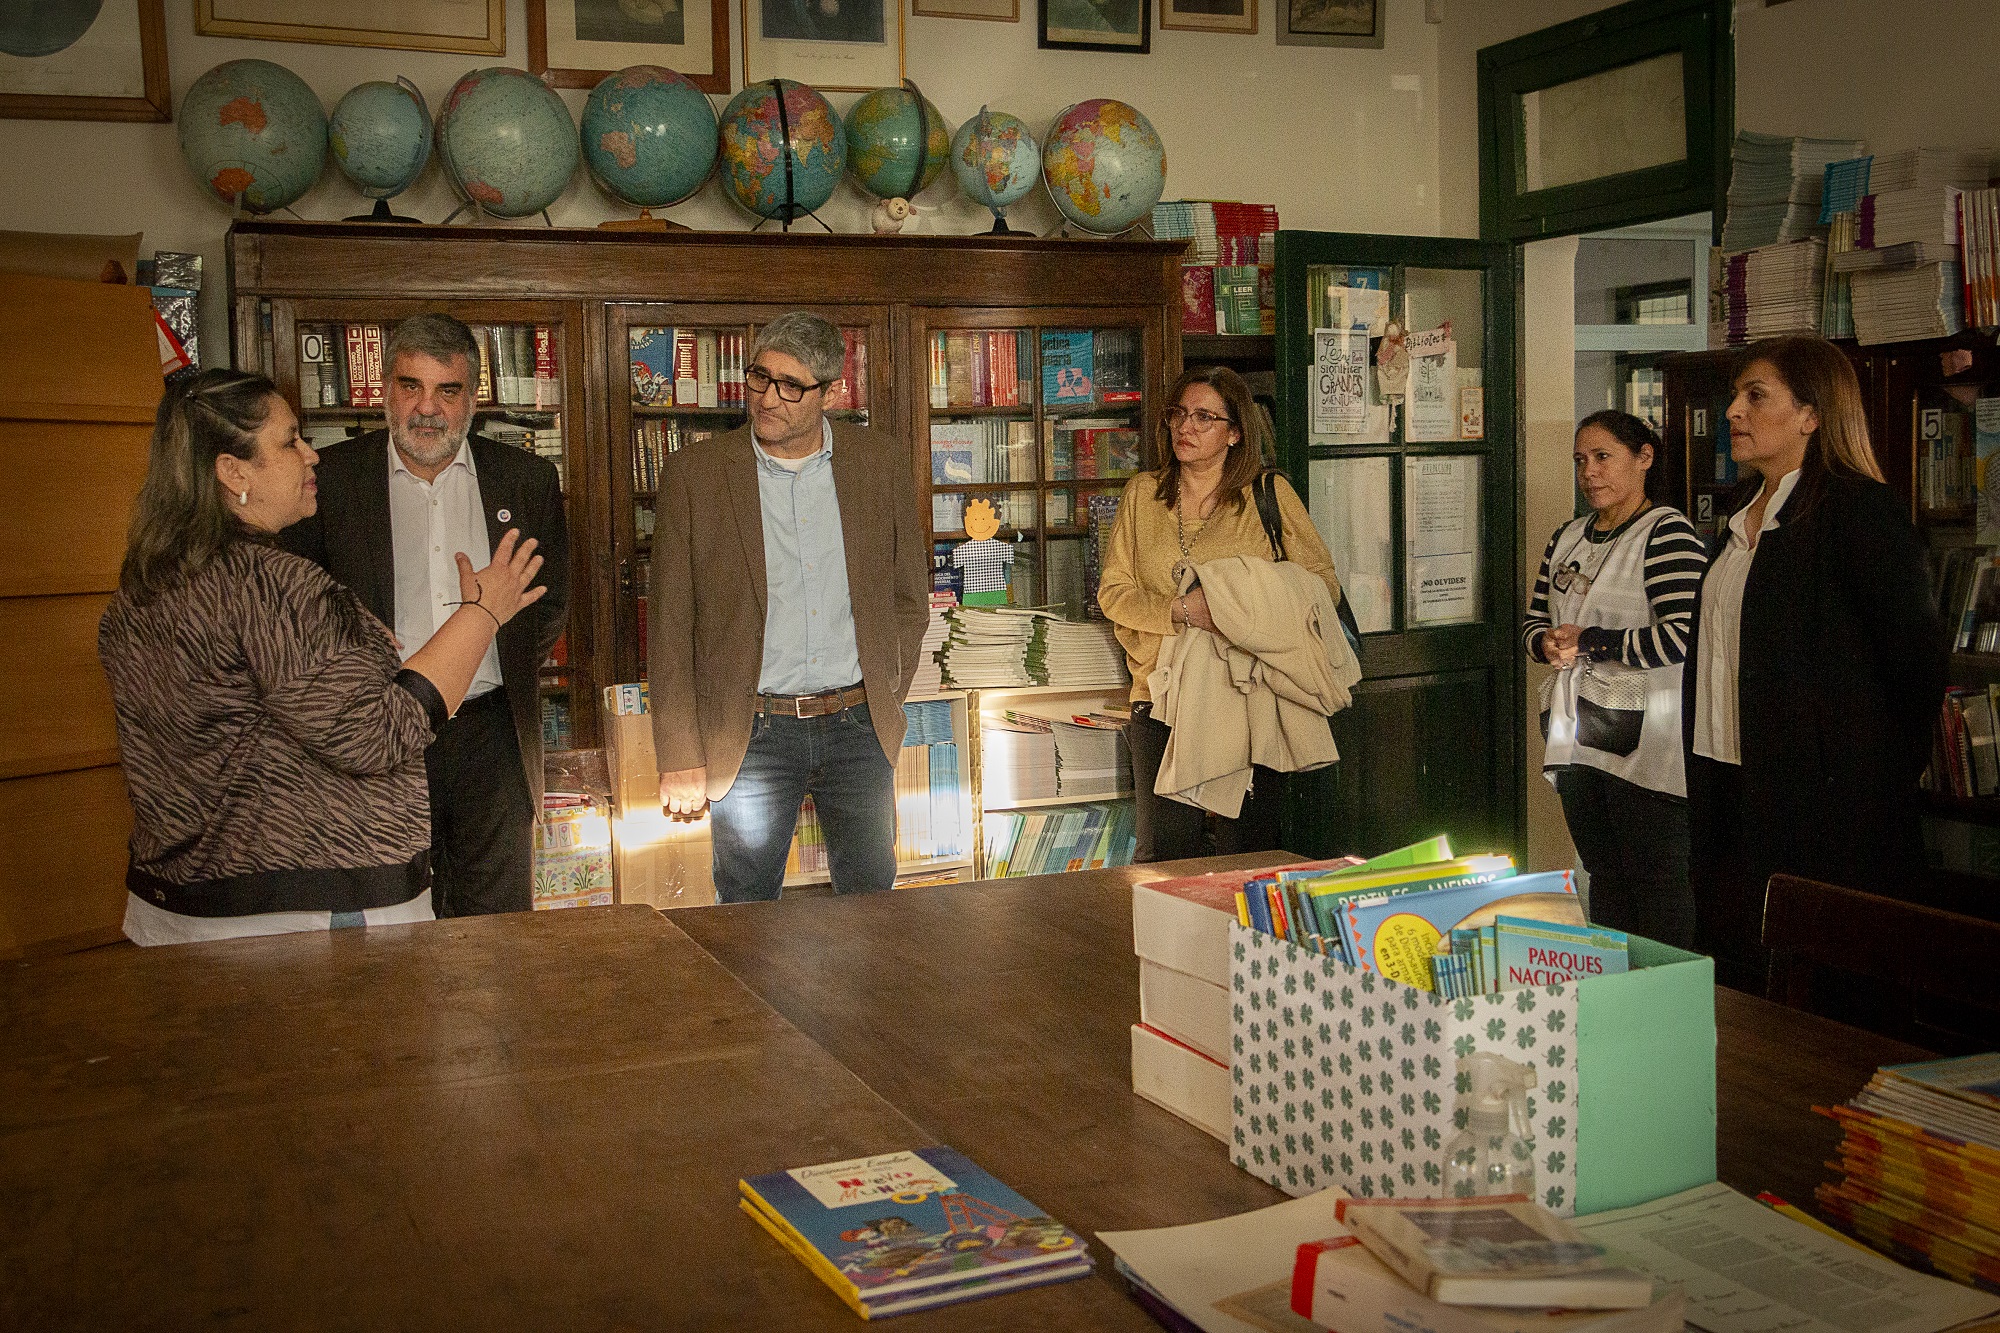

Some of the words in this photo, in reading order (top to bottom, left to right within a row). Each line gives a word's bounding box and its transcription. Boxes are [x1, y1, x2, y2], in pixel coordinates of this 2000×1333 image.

[1320, 375, 1363, 397] GRANDES
[1698, 412, 1705, 435] 1
[1925, 412, 1939, 439] 5
[1700, 497, 1711, 519] 2
[1393, 924, 1404, 936] de
[1407, 928, 1416, 936] 6
[1421, 932, 1434, 956] Inclu
[1380, 947, 1390, 961] en
[1386, 961, 1400, 979] 3-D
[1385, 936, 1401, 957] para
[1396, 958, 1414, 985] armar
[1528, 947, 1603, 975] PARQUES
[1509, 965, 1584, 987] NACIO
